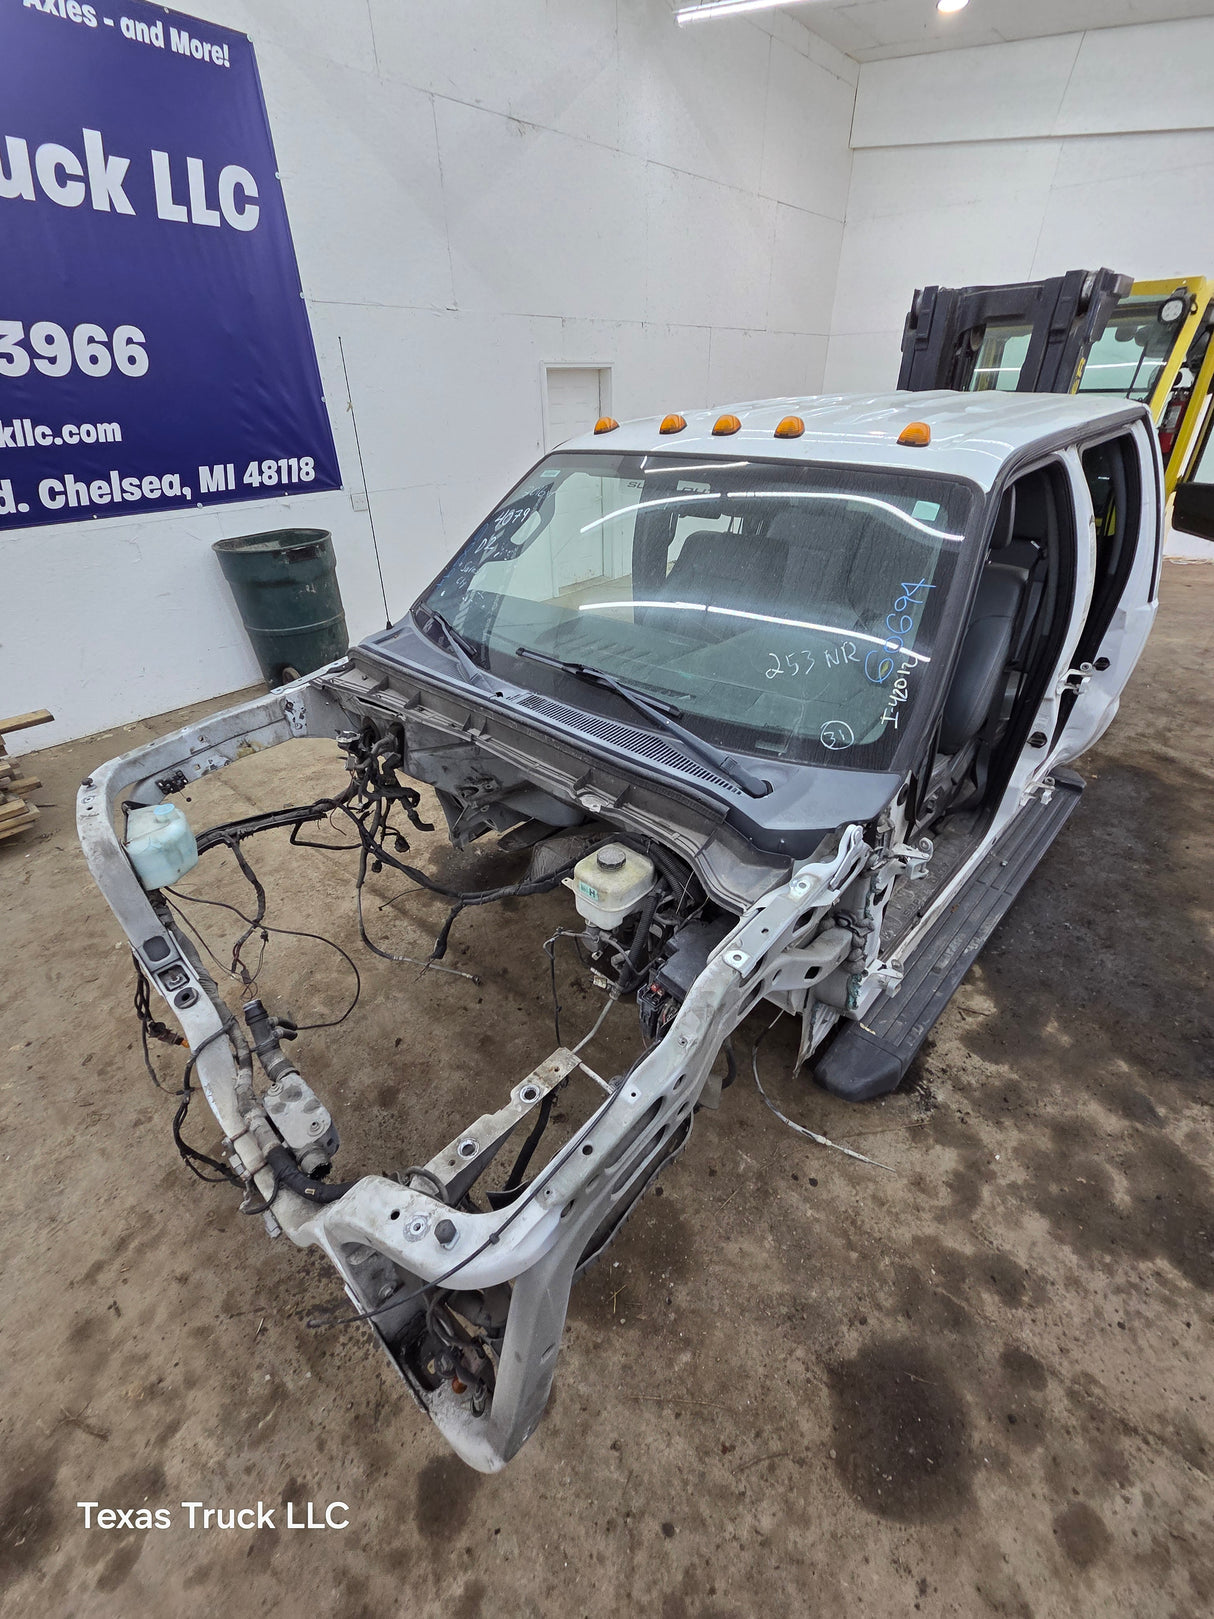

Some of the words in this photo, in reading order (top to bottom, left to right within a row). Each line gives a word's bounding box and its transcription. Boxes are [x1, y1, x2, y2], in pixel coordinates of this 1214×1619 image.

[120, 16, 164, 48] and
[170, 27, 231, 68] More!
[151, 149, 259, 232] LLC
[0, 319, 150, 378] 3966
[0, 418, 123, 449] kllc.com
[38, 470, 192, 510] Chelsea,
[199, 463, 236, 494] MI
[243, 456, 316, 488] 48118
[765, 650, 816, 679] 253
[825, 641, 861, 668] NR
